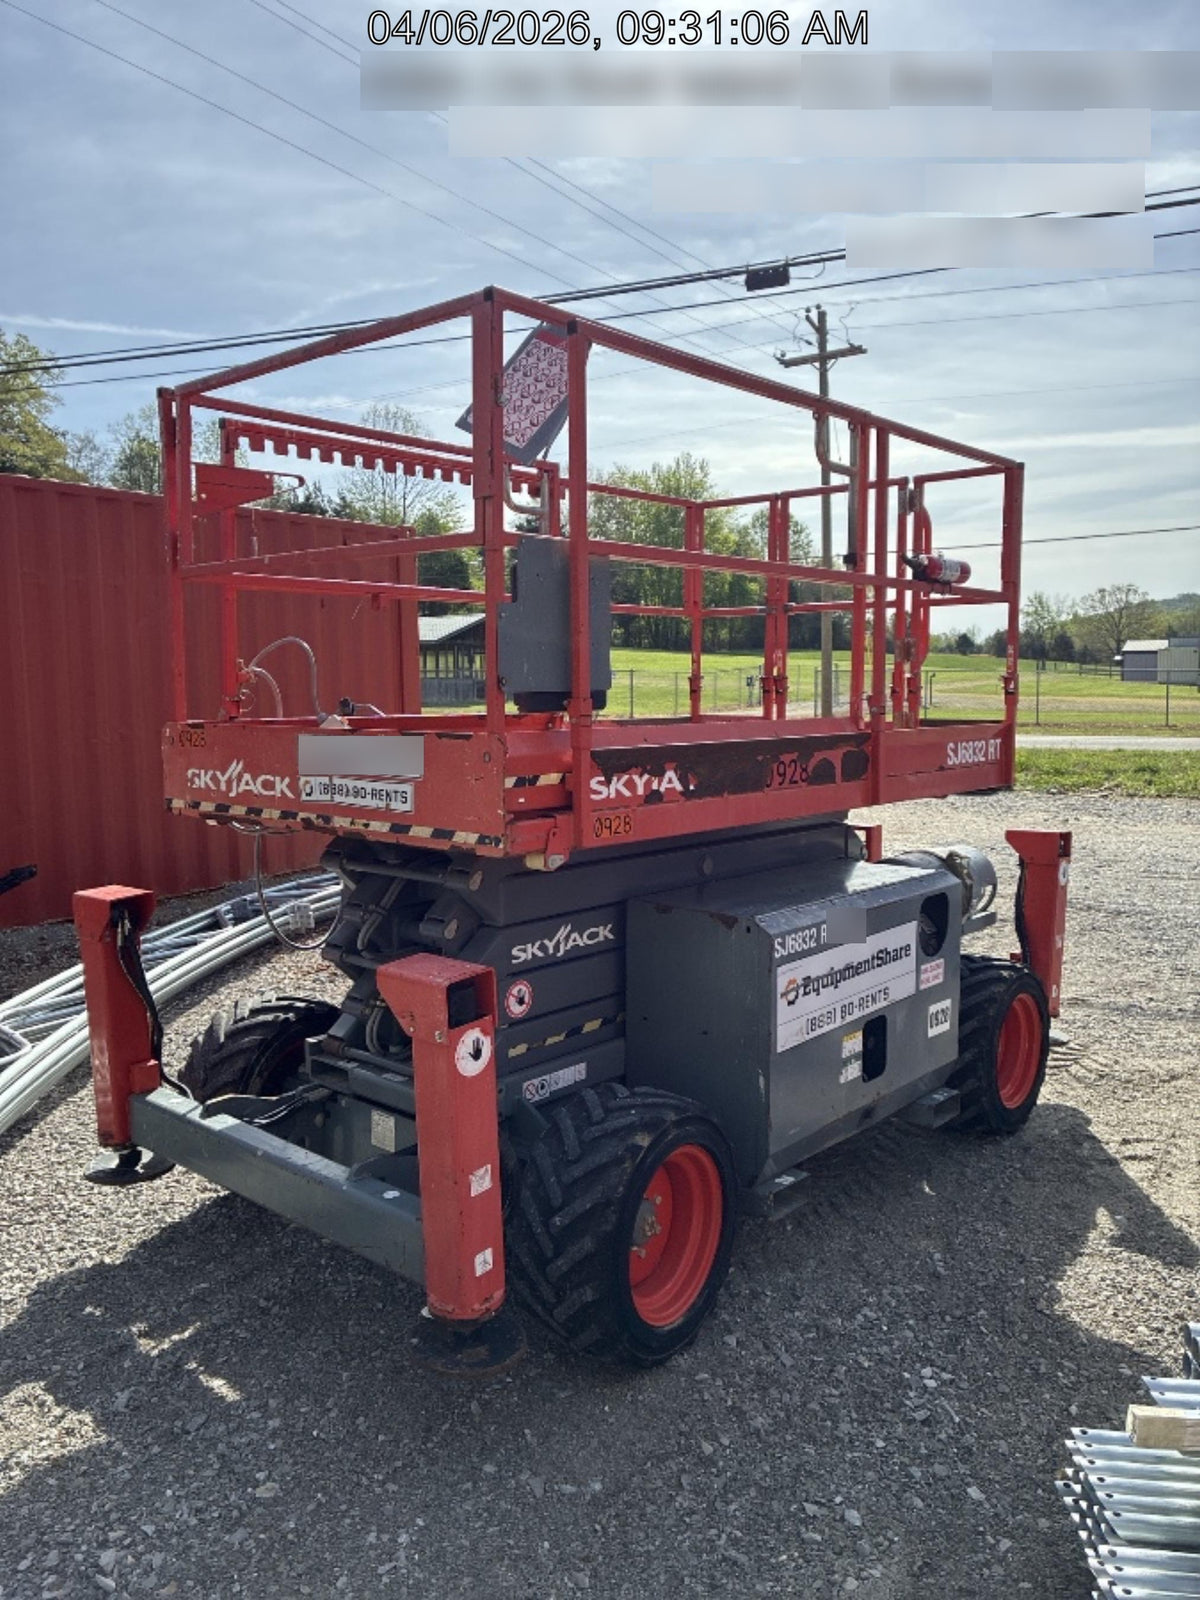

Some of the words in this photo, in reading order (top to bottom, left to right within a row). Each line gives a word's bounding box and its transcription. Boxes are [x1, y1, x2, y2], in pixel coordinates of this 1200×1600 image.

[946, 740, 986, 765] SJ6832
[988, 738, 1002, 760] RT
[187, 758, 295, 799] SKYJACK
[594, 815, 632, 838] 0928
[511, 923, 615, 964] SKYJACK
[774, 927, 817, 959] SJ6832
[801, 943, 912, 997] EquipmentShare
